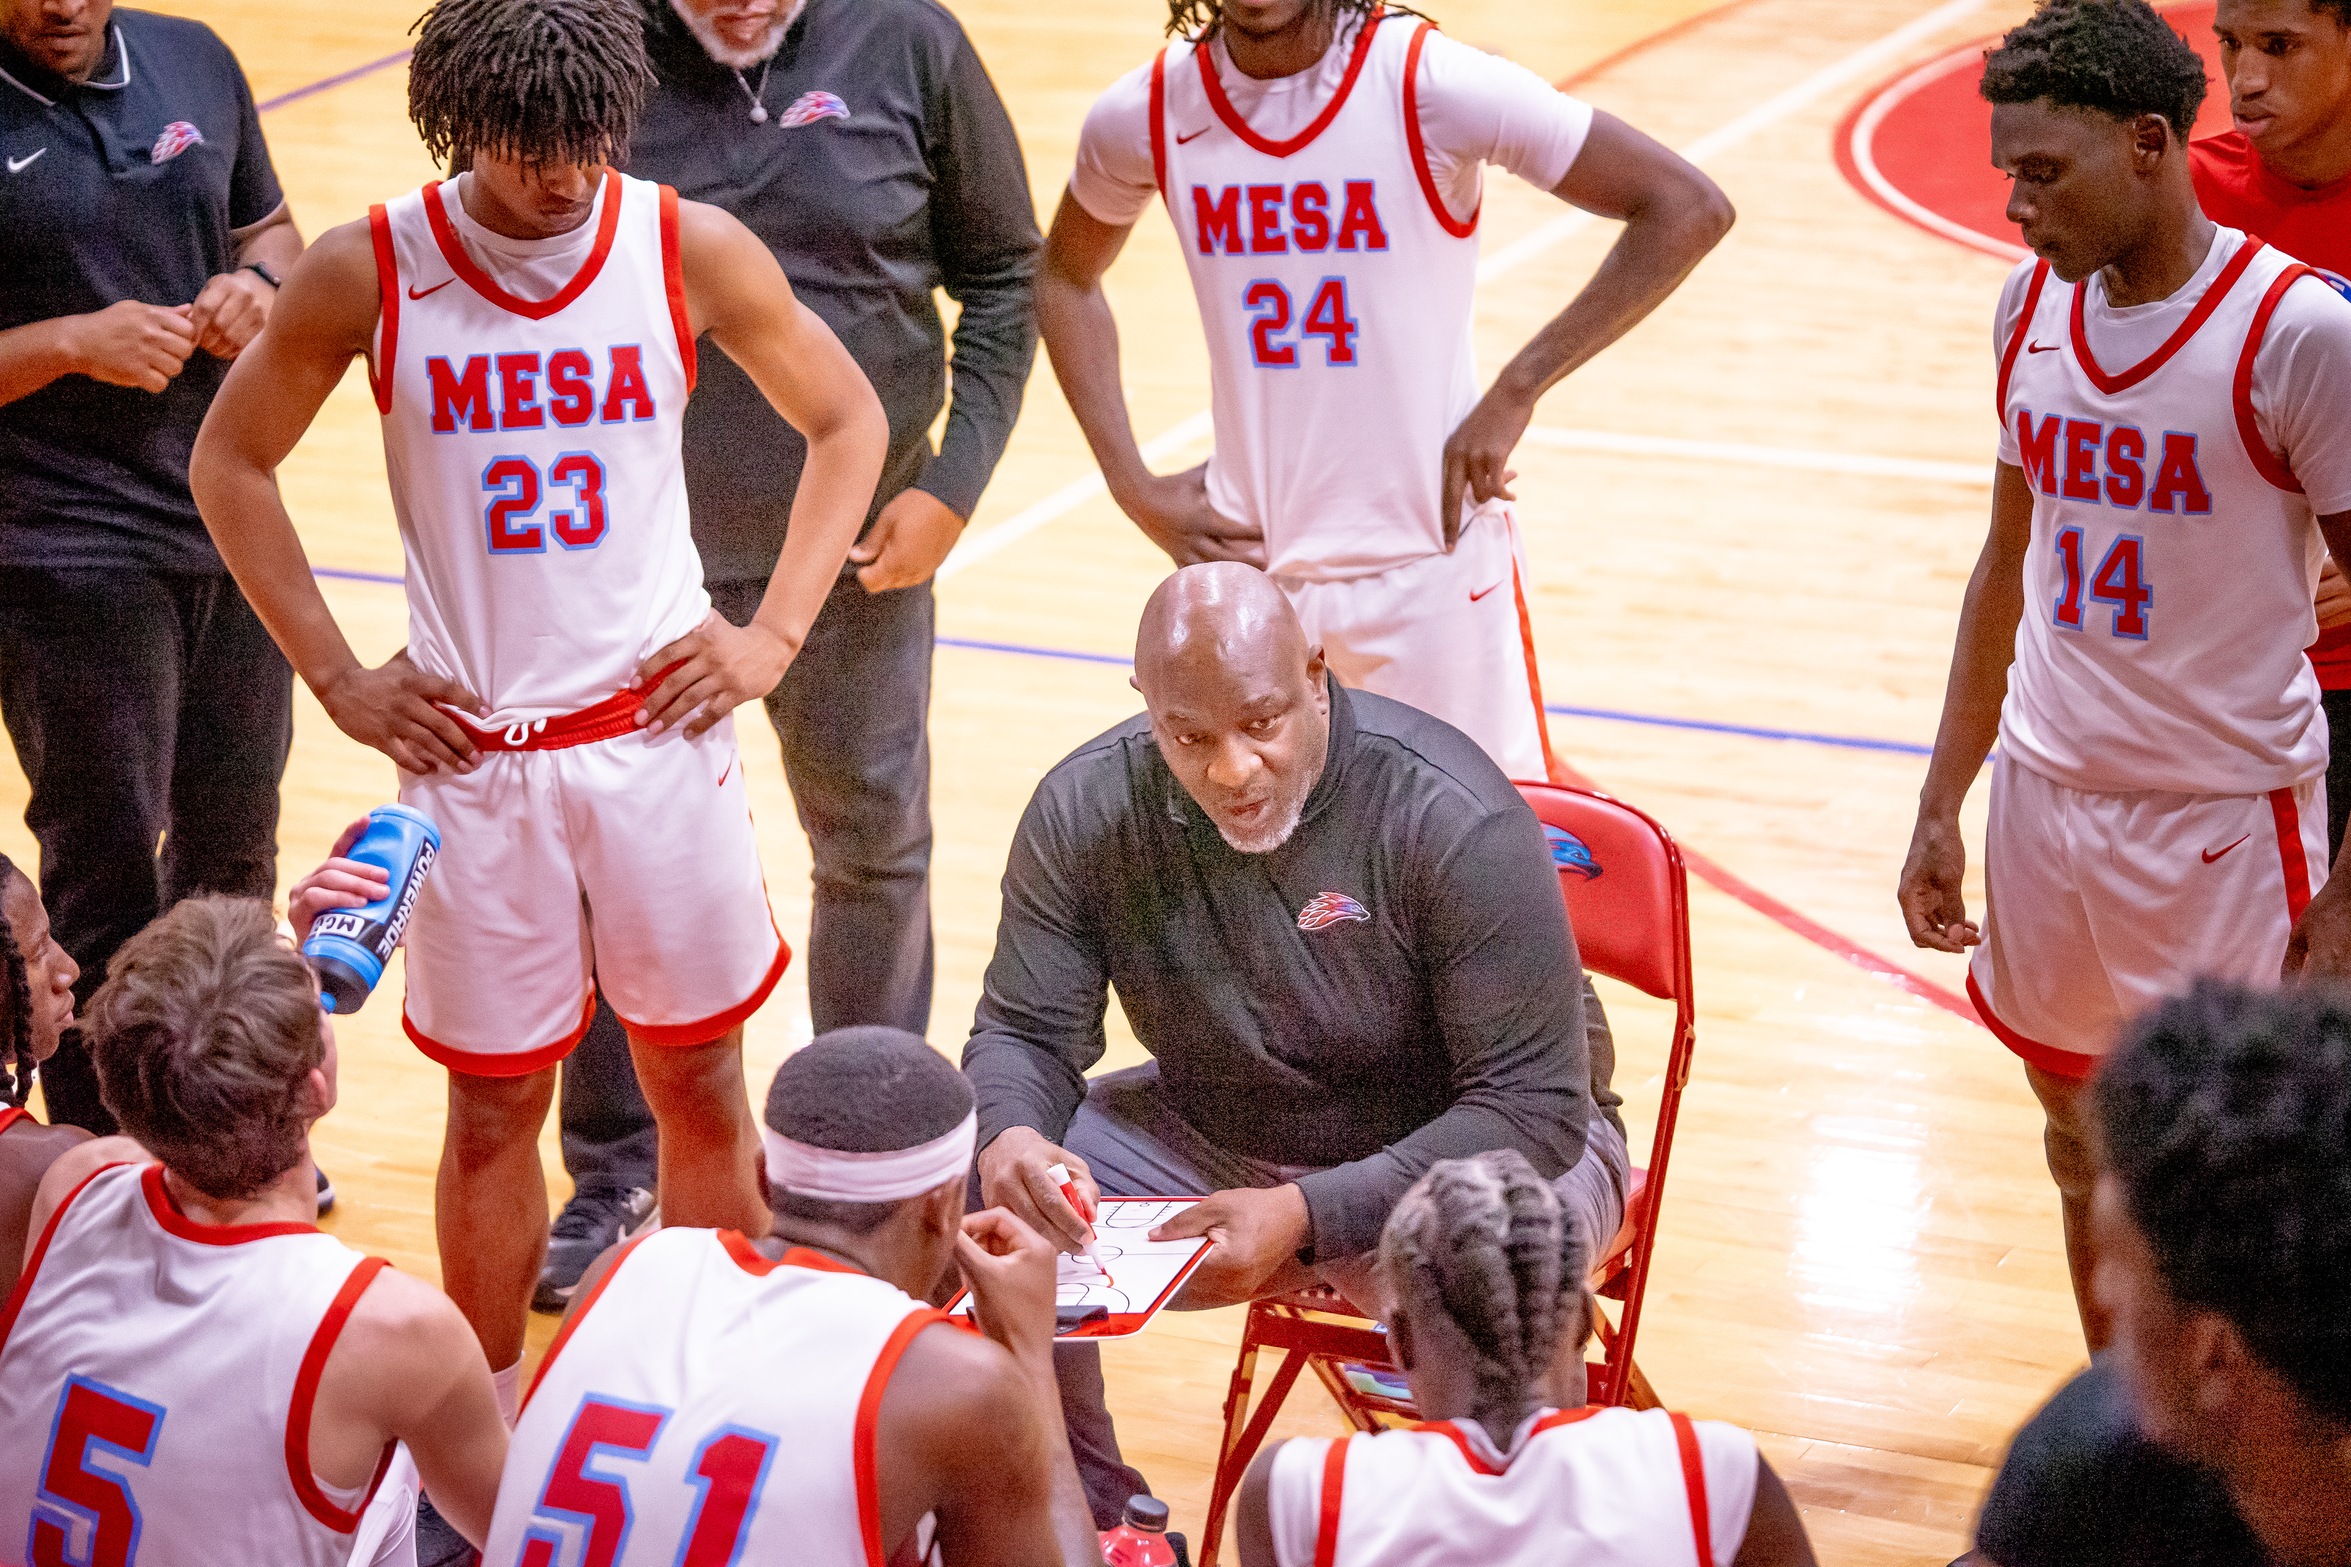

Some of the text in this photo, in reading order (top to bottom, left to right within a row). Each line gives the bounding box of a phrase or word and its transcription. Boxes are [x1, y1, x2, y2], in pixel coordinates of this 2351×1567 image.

[1191, 179, 1389, 256] MESA
[1242, 275, 1359, 369] 24
[425, 343, 656, 435] MESA
[481, 450, 610, 555] 23
[2017, 408, 2212, 515] MESA
[2053, 525, 2153, 641] 14
[376, 841, 436, 960] POWERADE
[25, 1372, 168, 1567] 5
[514, 1391, 781, 1567] 51
